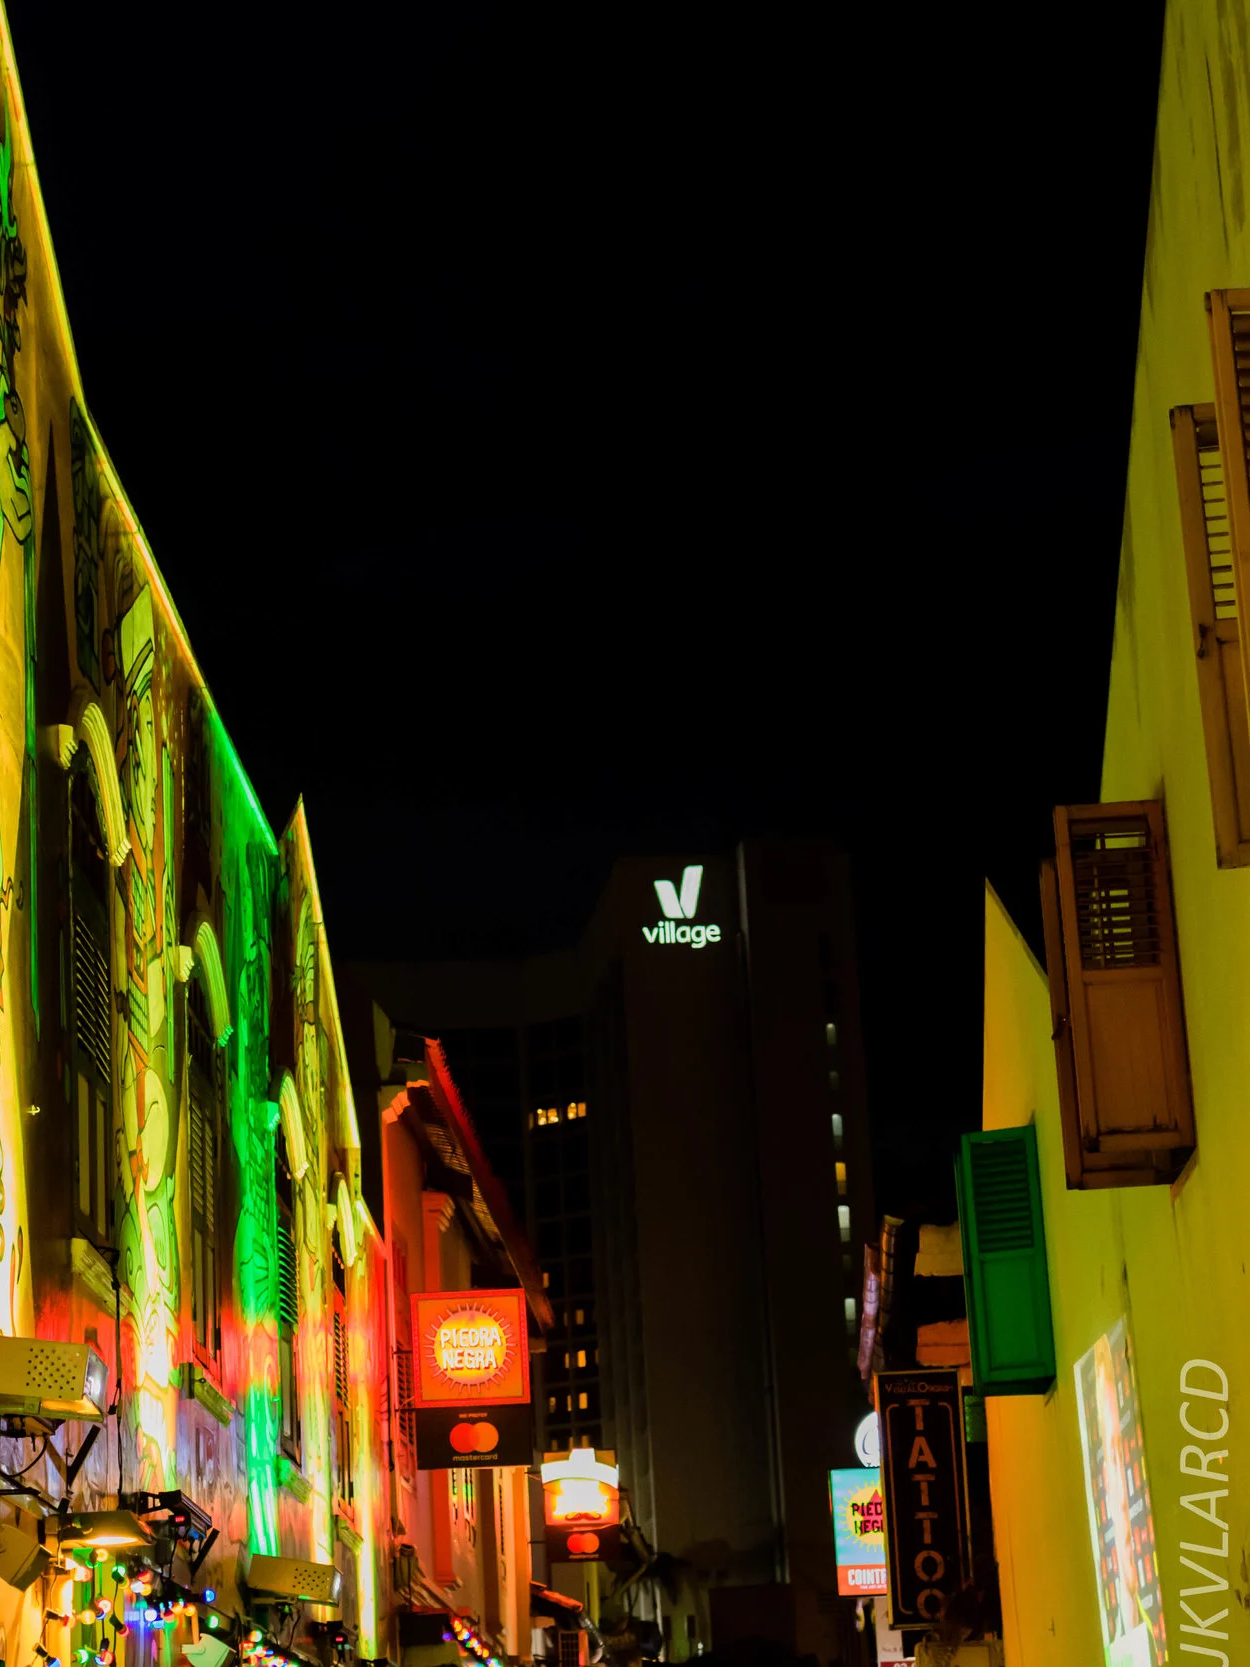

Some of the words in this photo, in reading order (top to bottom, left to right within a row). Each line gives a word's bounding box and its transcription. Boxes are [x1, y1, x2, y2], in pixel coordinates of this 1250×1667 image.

[642, 920, 722, 949] village
[440, 1327, 502, 1348] PIEDRA
[441, 1349, 498, 1370] NEGRA
[452, 1453, 498, 1462] mastercard
[906, 1398, 947, 1621] TATTOO
[854, 1520, 884, 1534] NEG
